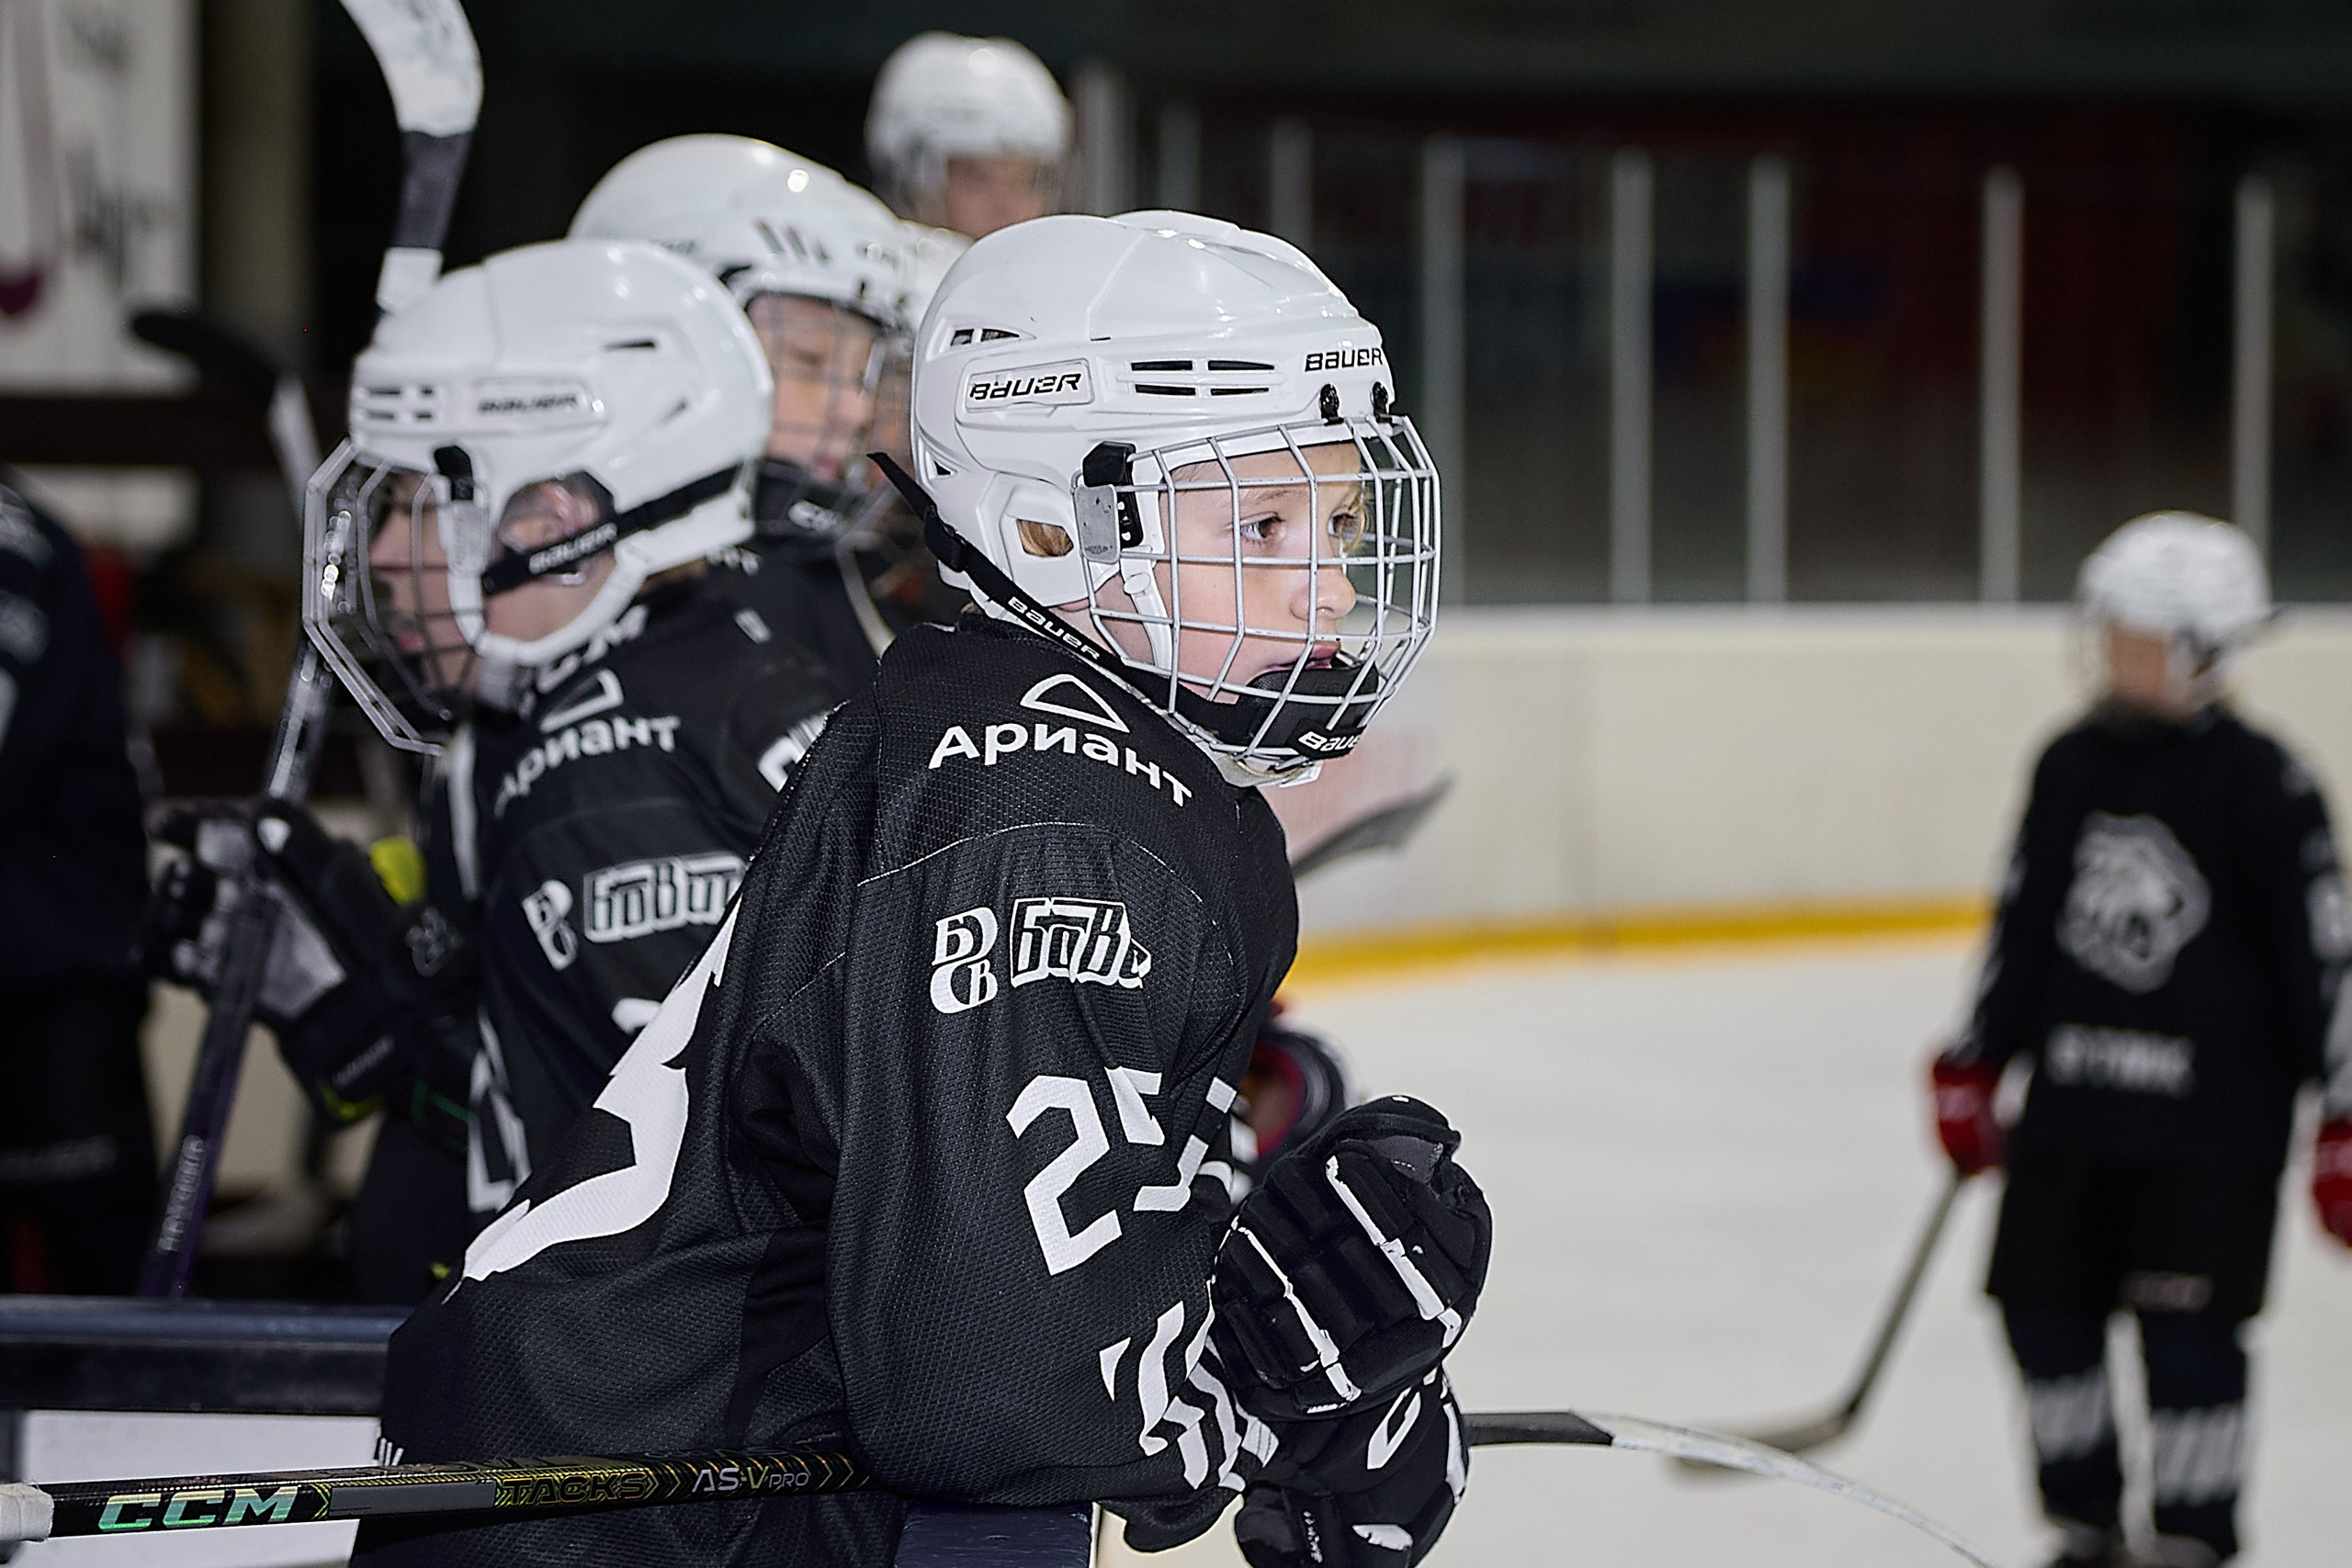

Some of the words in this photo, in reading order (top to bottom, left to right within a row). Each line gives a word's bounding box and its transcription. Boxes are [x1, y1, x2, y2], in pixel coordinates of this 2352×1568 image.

[1305, 347, 1383, 372] BAUER
[969, 373, 1081, 400] BAUER
[1008, 596, 1100, 660] BAUER
[1298, 731, 1360, 751] BAUE
[1006, 1066, 1237, 1276] 25
[98, 1485, 299, 1531] CCM
[502, 1471, 649, 1506] TACKS
[768, 1472, 810, 1488] PRO
